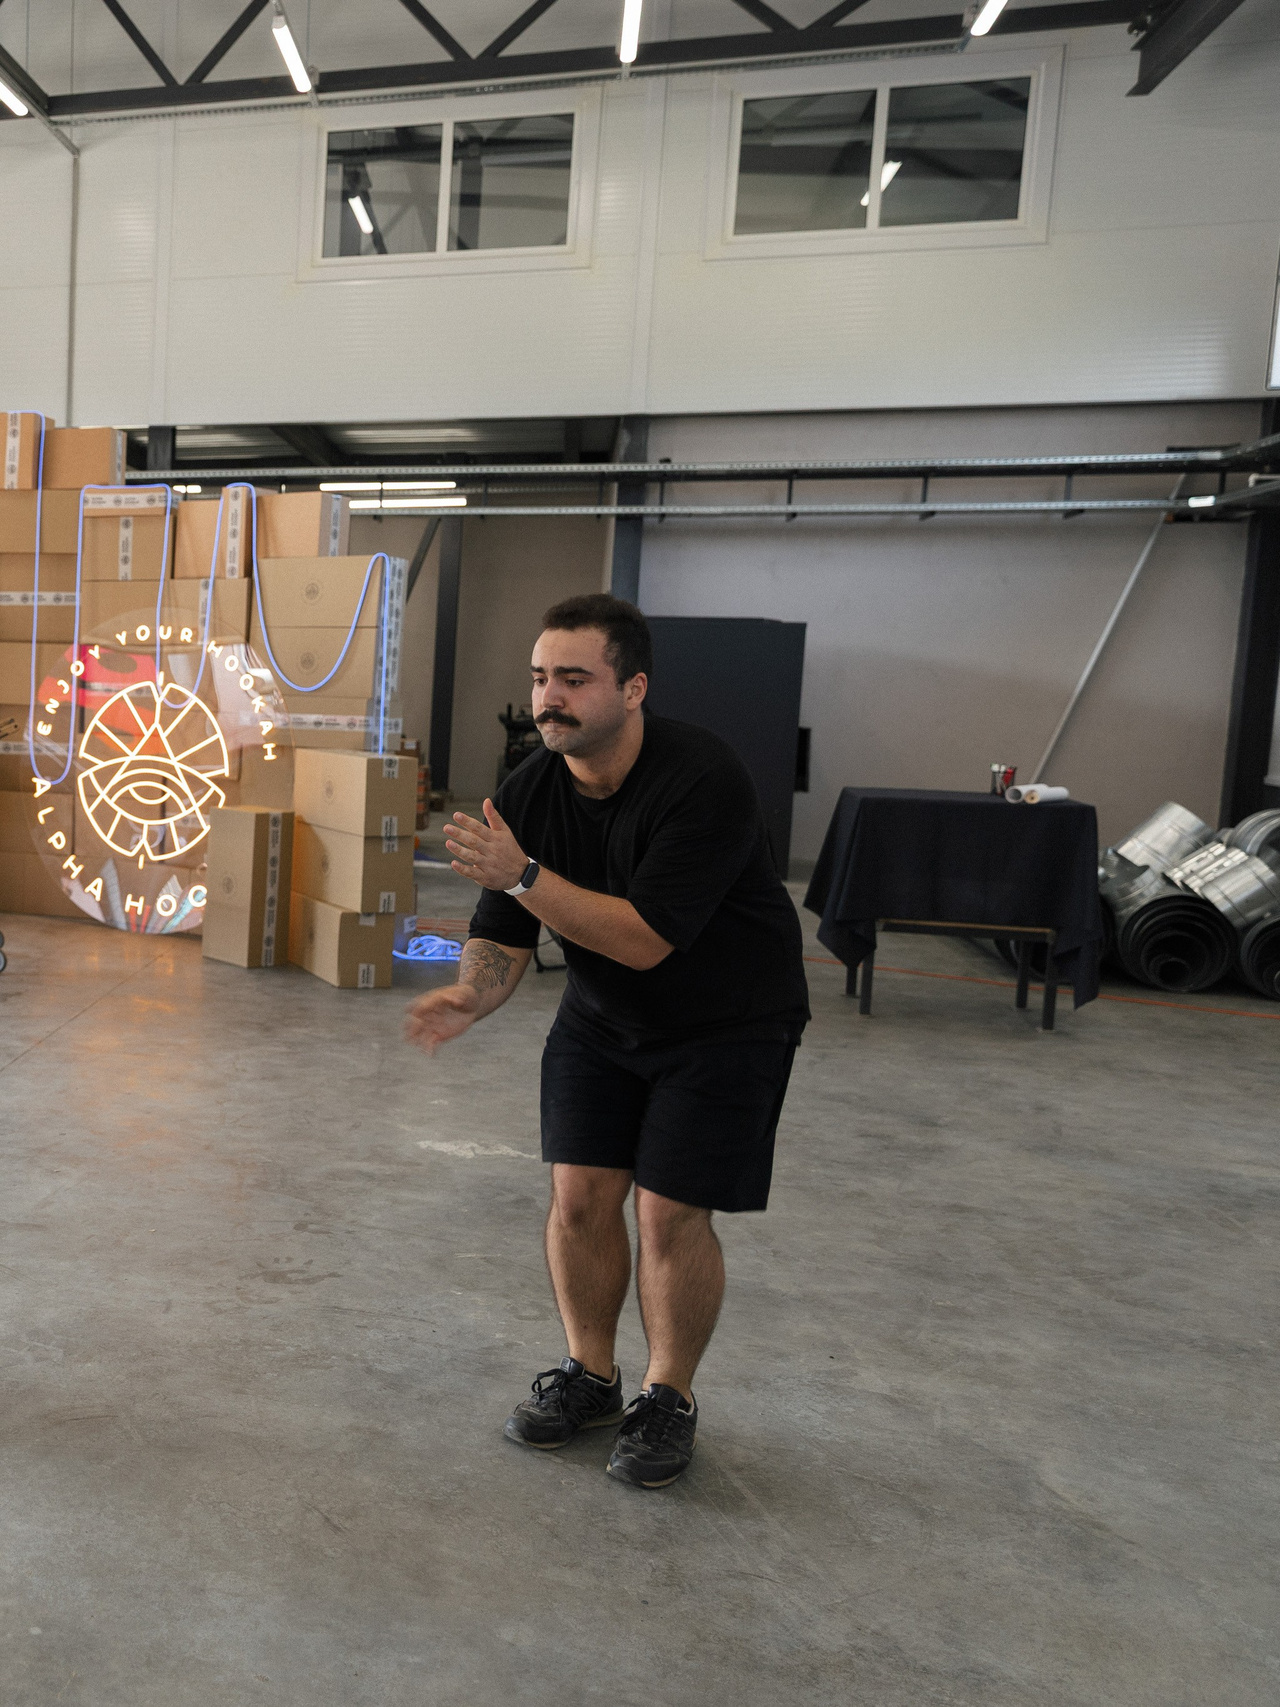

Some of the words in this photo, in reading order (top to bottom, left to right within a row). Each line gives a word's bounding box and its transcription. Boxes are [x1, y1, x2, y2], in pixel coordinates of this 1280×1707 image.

[37, 644, 101, 737] ENJOY
[115, 624, 194, 646] YOUR
[206, 639, 278, 761] HOOKAH
[31, 776, 104, 902] ALPHA
